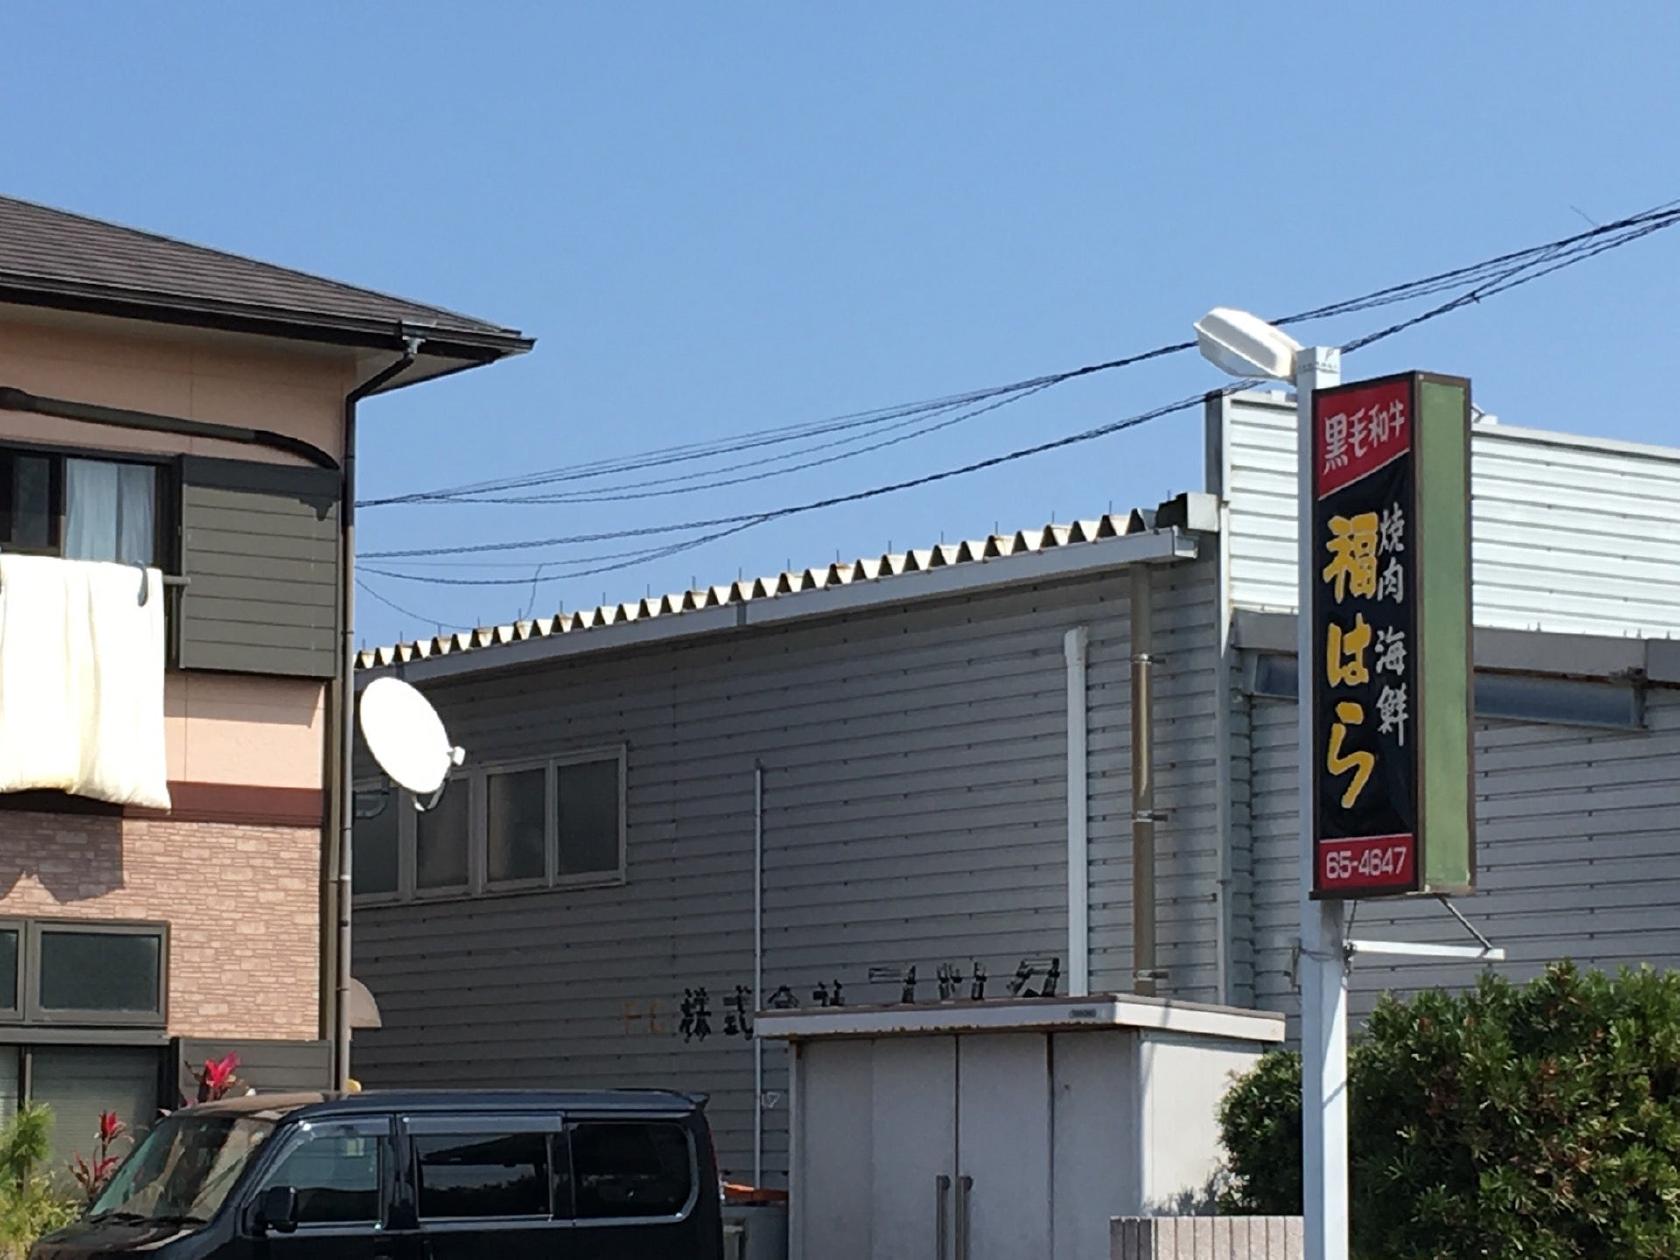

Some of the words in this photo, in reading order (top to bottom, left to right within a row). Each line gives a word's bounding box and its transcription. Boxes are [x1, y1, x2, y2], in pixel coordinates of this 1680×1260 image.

[1323, 399, 1405, 475] 黒毛和牛
[1377, 501, 1405, 604] 焼肉
[1322, 511, 1378, 809] 福はら
[1375, 626, 1409, 747] 海鮮
[1326, 847, 1407, 879] 65-4647
